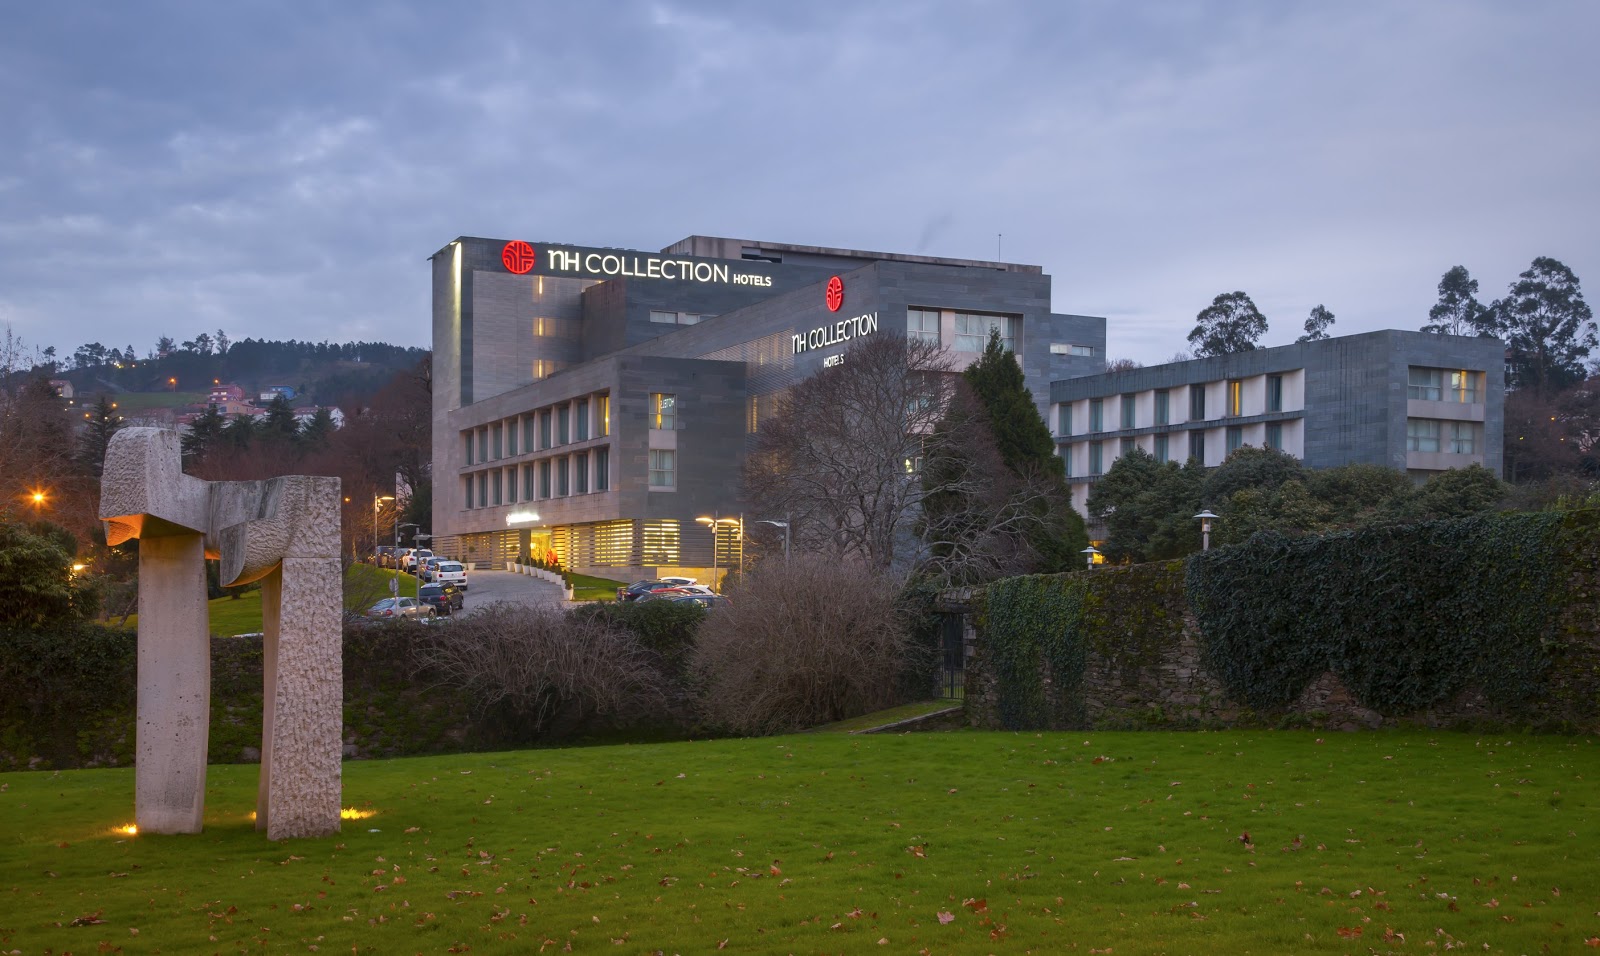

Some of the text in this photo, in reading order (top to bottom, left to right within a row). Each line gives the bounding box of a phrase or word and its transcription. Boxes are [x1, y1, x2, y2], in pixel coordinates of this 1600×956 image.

[585, 253, 729, 283] COLLECTION
[733, 273, 772, 287] HOTELS
[809, 311, 878, 349] COLLECTION
[823, 353, 845, 368] HOTELS
